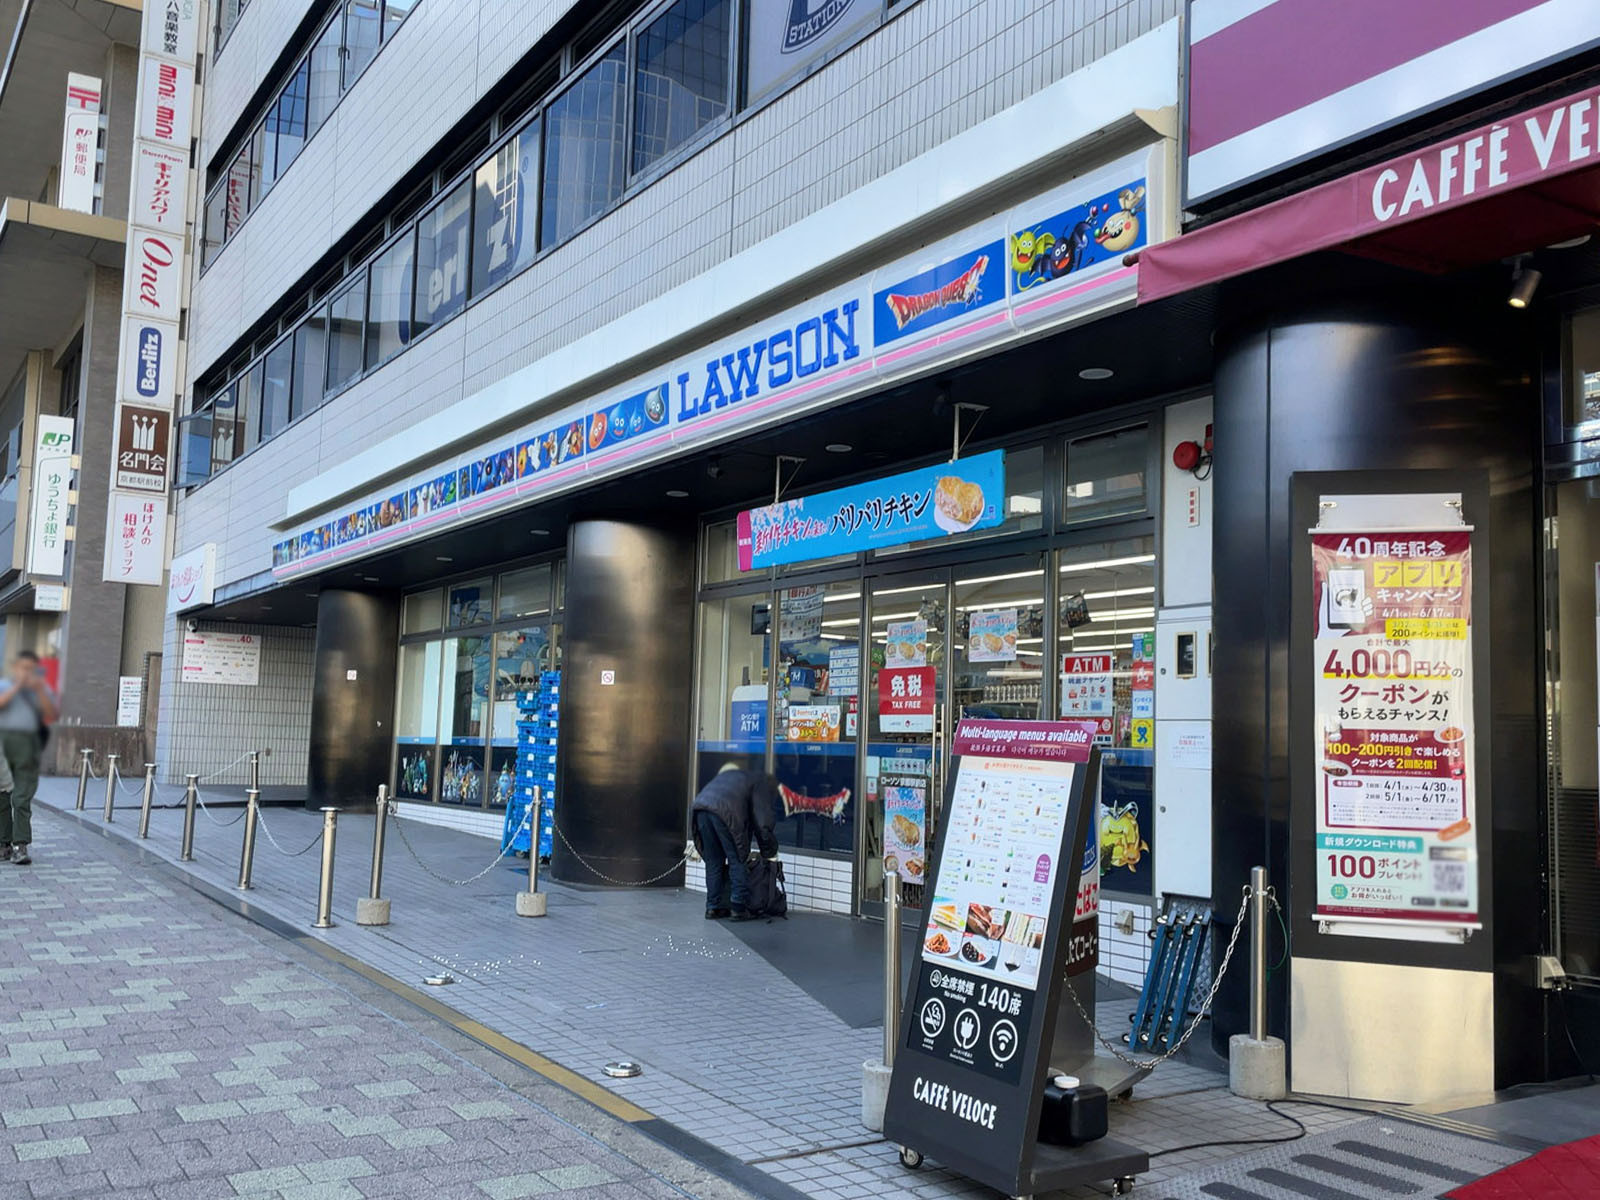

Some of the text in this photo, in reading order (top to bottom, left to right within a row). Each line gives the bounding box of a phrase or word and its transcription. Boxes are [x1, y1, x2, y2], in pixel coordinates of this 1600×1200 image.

[788, 0, 850, 42] STATION
[141, 333, 159, 391] Berlitz
[677, 297, 860, 423] LAWSON
[119, 453, 166, 472] 名門会
[43, 473, 62, 548] ゆうちょ銀行
[831, 487, 933, 536] パリパリチキン
[141, 502, 154, 545] ほけんの
[121, 512, 138, 576] 相談ショップ
[1336, 537, 1446, 559] 40周年記念
[1378, 564, 1456, 585] アプリ
[1377, 588, 1462, 602] キャンペーン
[1072, 657, 1105, 673] ATM
[1324, 648, 1463, 679] 4,000円分の
[890, 674, 923, 698] 免税
[1339, 683, 1449, 705] クーポンが
[891, 700, 921, 709] TAX FREE
[1338, 707, 1449, 722] もらえるチャンス!
[740, 722, 760, 732] ATM
[960, 726, 1089, 743] Multi-language menus available
[1327, 854, 1421, 879] 100 ポイント
[977, 983, 1010, 1013] 140
[952, 1089, 998, 1130] VELOCE
